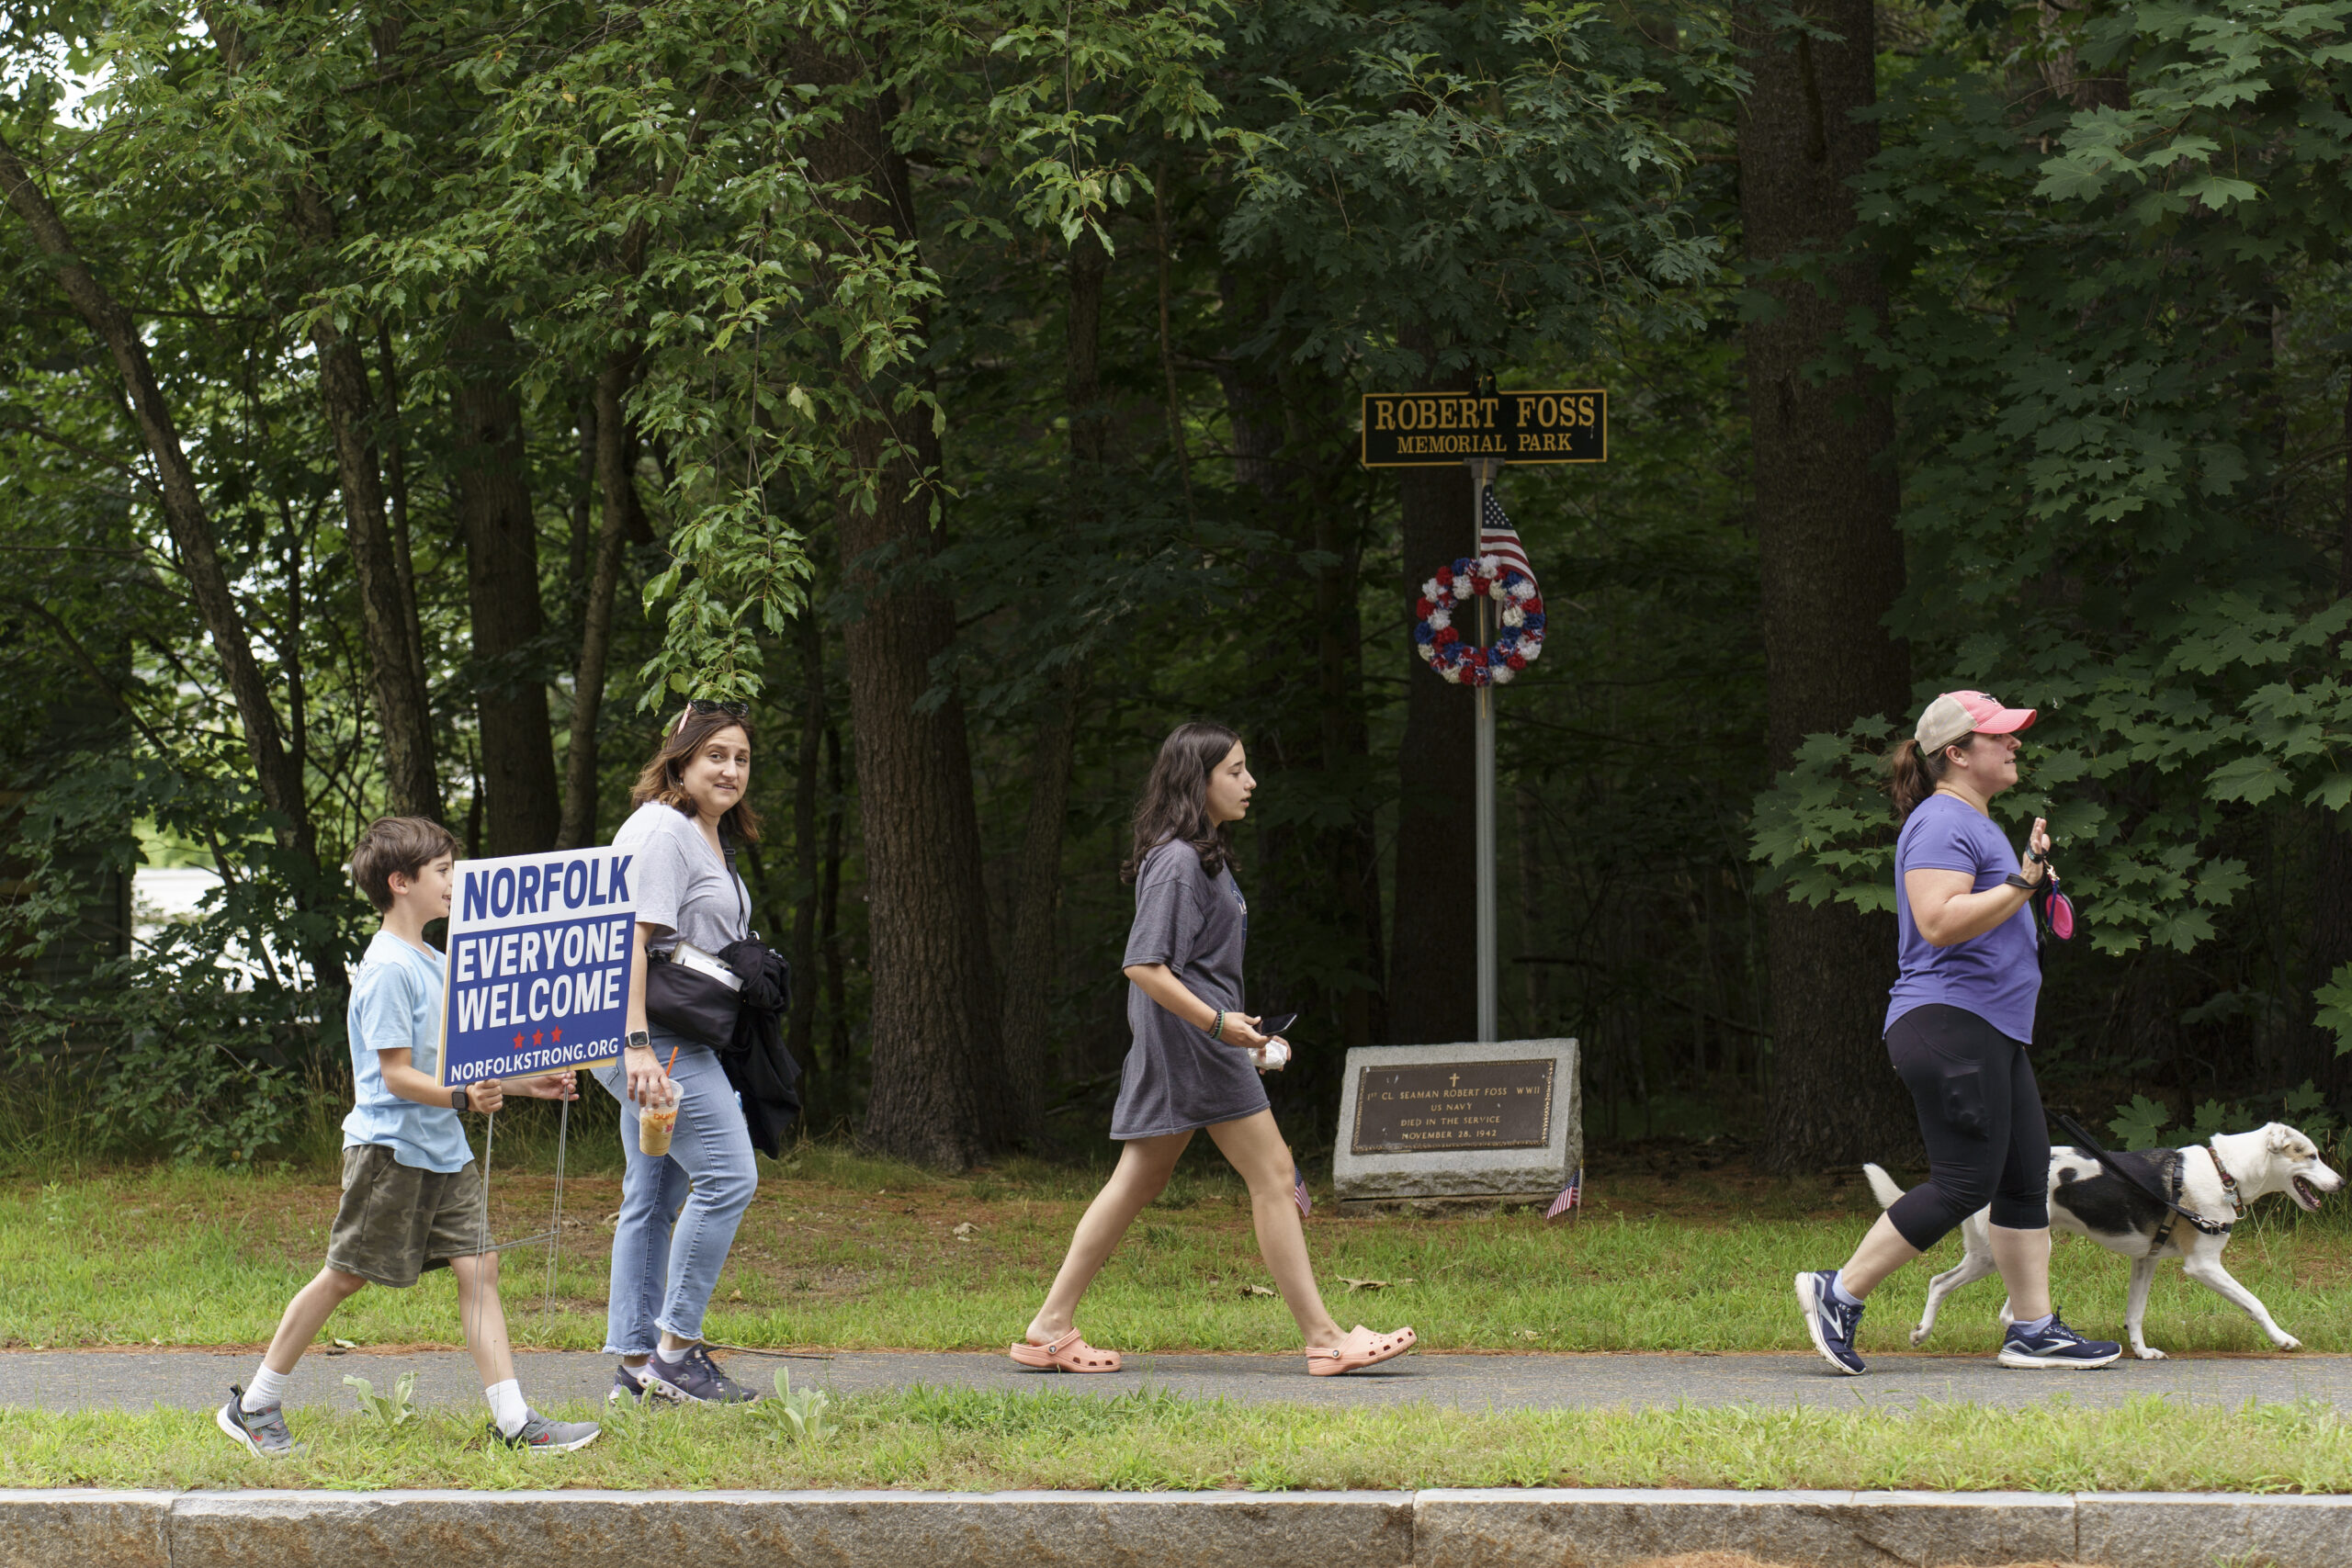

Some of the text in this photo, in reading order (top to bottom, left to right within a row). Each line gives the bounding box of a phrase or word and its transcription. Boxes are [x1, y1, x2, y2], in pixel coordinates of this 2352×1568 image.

[1374, 396, 1595, 431] ROBERT FOSS
[1396, 433, 1573, 454] MEMORIAL PARK
[463, 854, 633, 922] NORFOLK
[457, 919, 628, 983] EVERYONE
[457, 967, 623, 1033] WELCOME
[450, 1037, 619, 1083] NORFOLKSTRONG.ORG
[1399, 1090, 1440, 1100] SEAMAN
[1443, 1088, 1481, 1099] ROBERT
[1484, 1087, 1508, 1097] FOSS
[1516, 1086, 1541, 1095] WWII
[1446, 1102, 1473, 1111] NAVY
[1400, 1118, 1422, 1127] DIED
[1441, 1117, 1460, 1125] THE
[1464, 1115, 1500, 1124] SERVICE
[1401, 1131, 1453, 1140] NOVEMBER
[1476, 1129, 1498, 1138] 1942
